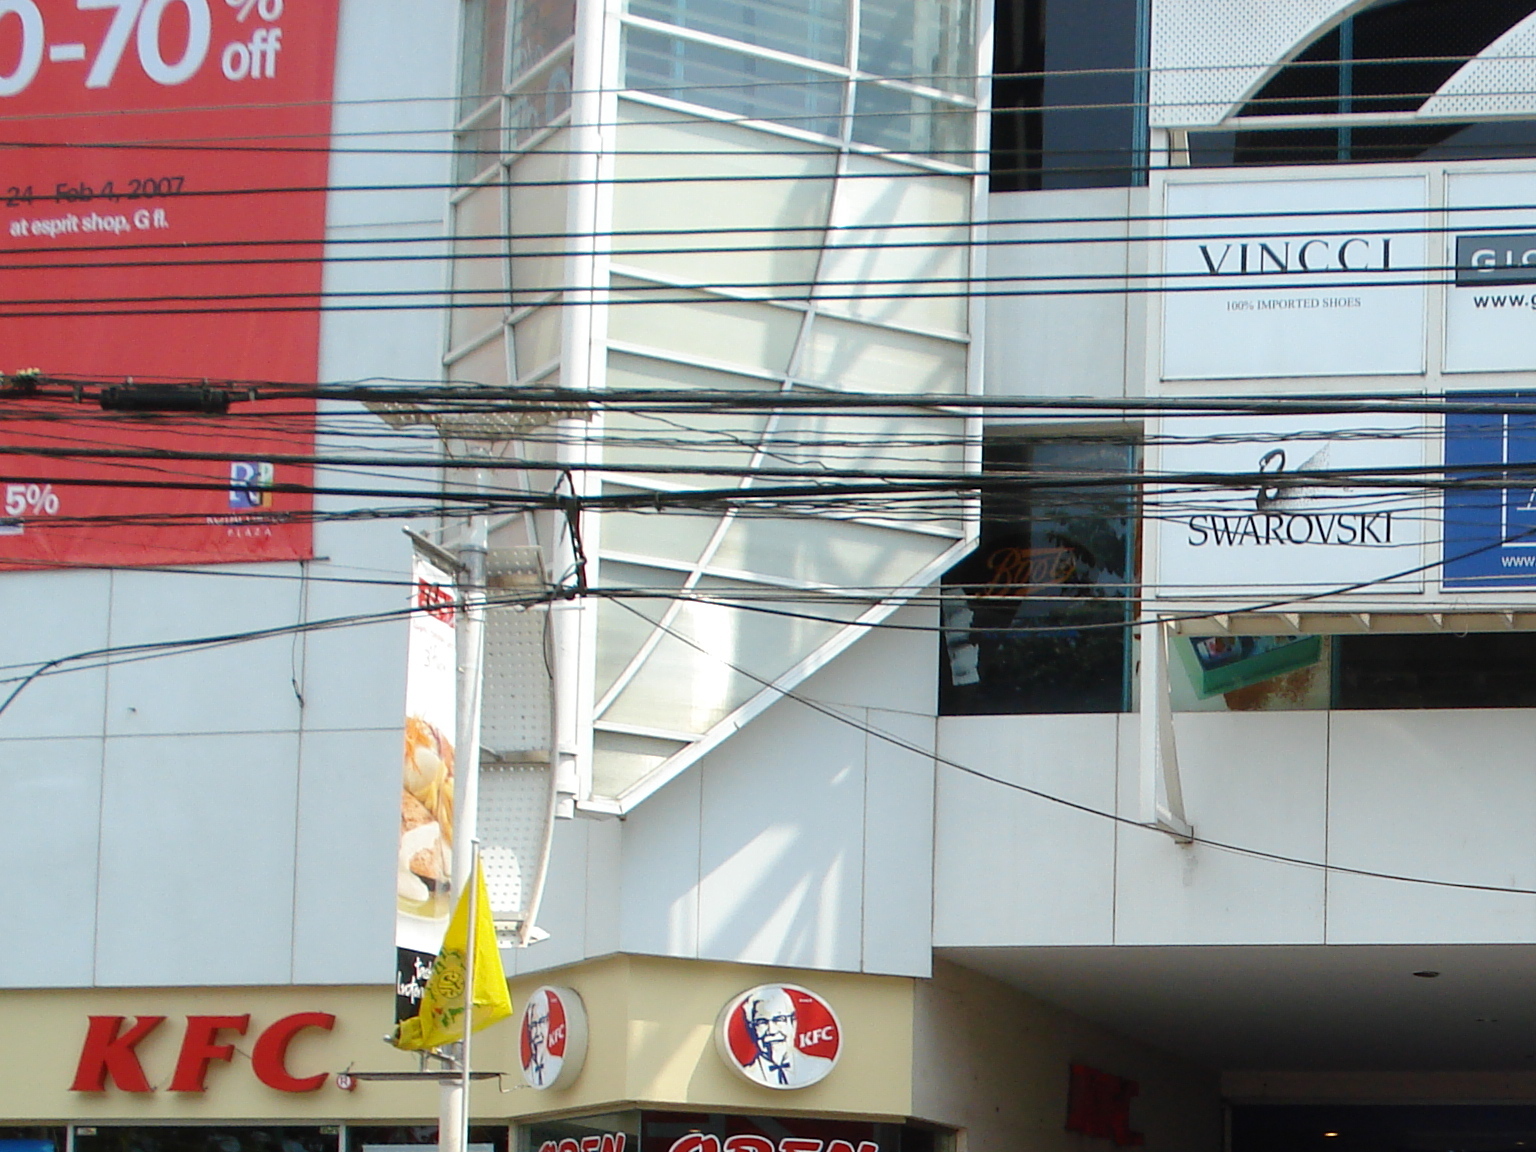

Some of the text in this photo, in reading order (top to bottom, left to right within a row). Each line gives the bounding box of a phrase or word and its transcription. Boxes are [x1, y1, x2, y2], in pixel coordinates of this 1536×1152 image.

[221, 28, 282, 81] off
[6, 186, 34, 208] 24
[55, 182, 94, 204] Feb
[128, 176, 186, 200] 2007
[10, 218, 30, 238] at
[31, 213, 80, 239] esprit
[81, 211, 131, 236] shop,
[134, 208, 151, 230] G
[1198, 237, 1393, 276] VINCCI
[1226, 296, 1362, 312] 100% IMPORTED SHOES
[1188, 511, 1395, 547] SWAROVSKI
[548, 1023, 565, 1049] KFC
[799, 1025, 835, 1048] KFC
[68, 1011, 337, 1094] KFC
